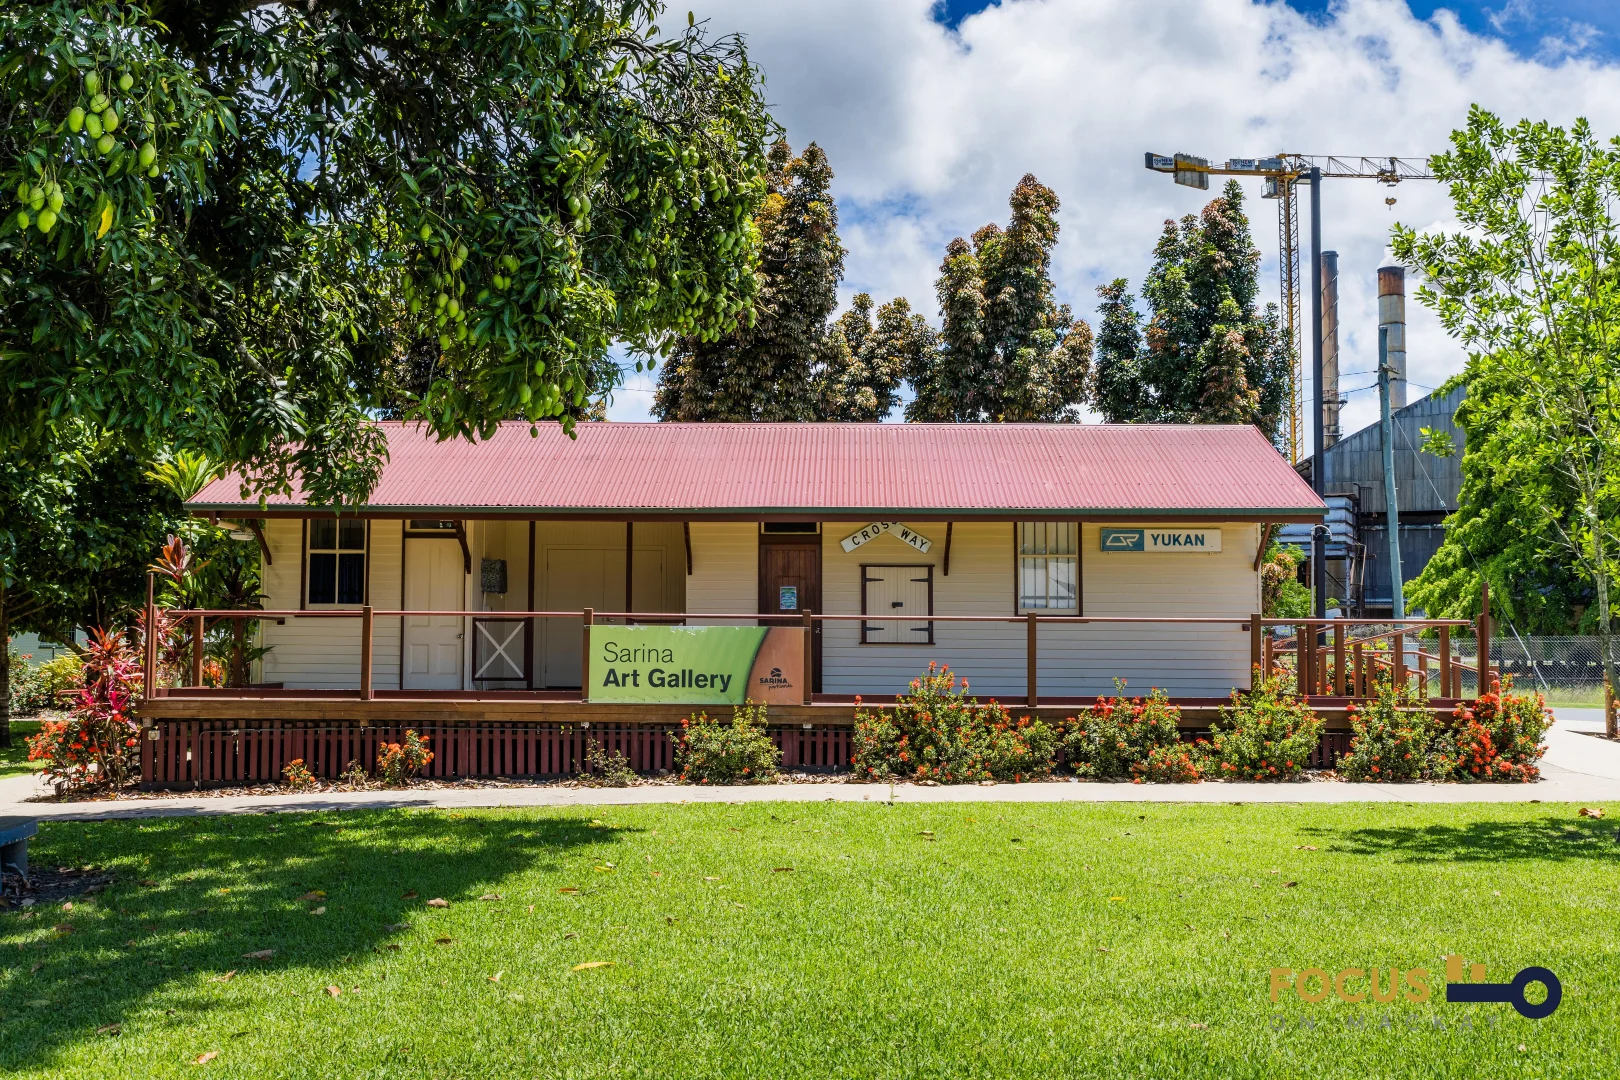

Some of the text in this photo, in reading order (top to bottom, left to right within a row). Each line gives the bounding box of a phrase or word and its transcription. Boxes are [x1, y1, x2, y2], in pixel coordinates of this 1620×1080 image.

[851, 522, 928, 549] CROS WAY
[1150, 533, 1205, 546] YUKAN
[603, 641, 674, 663] Sarina
[602, 668, 732, 693] Art Gallery
